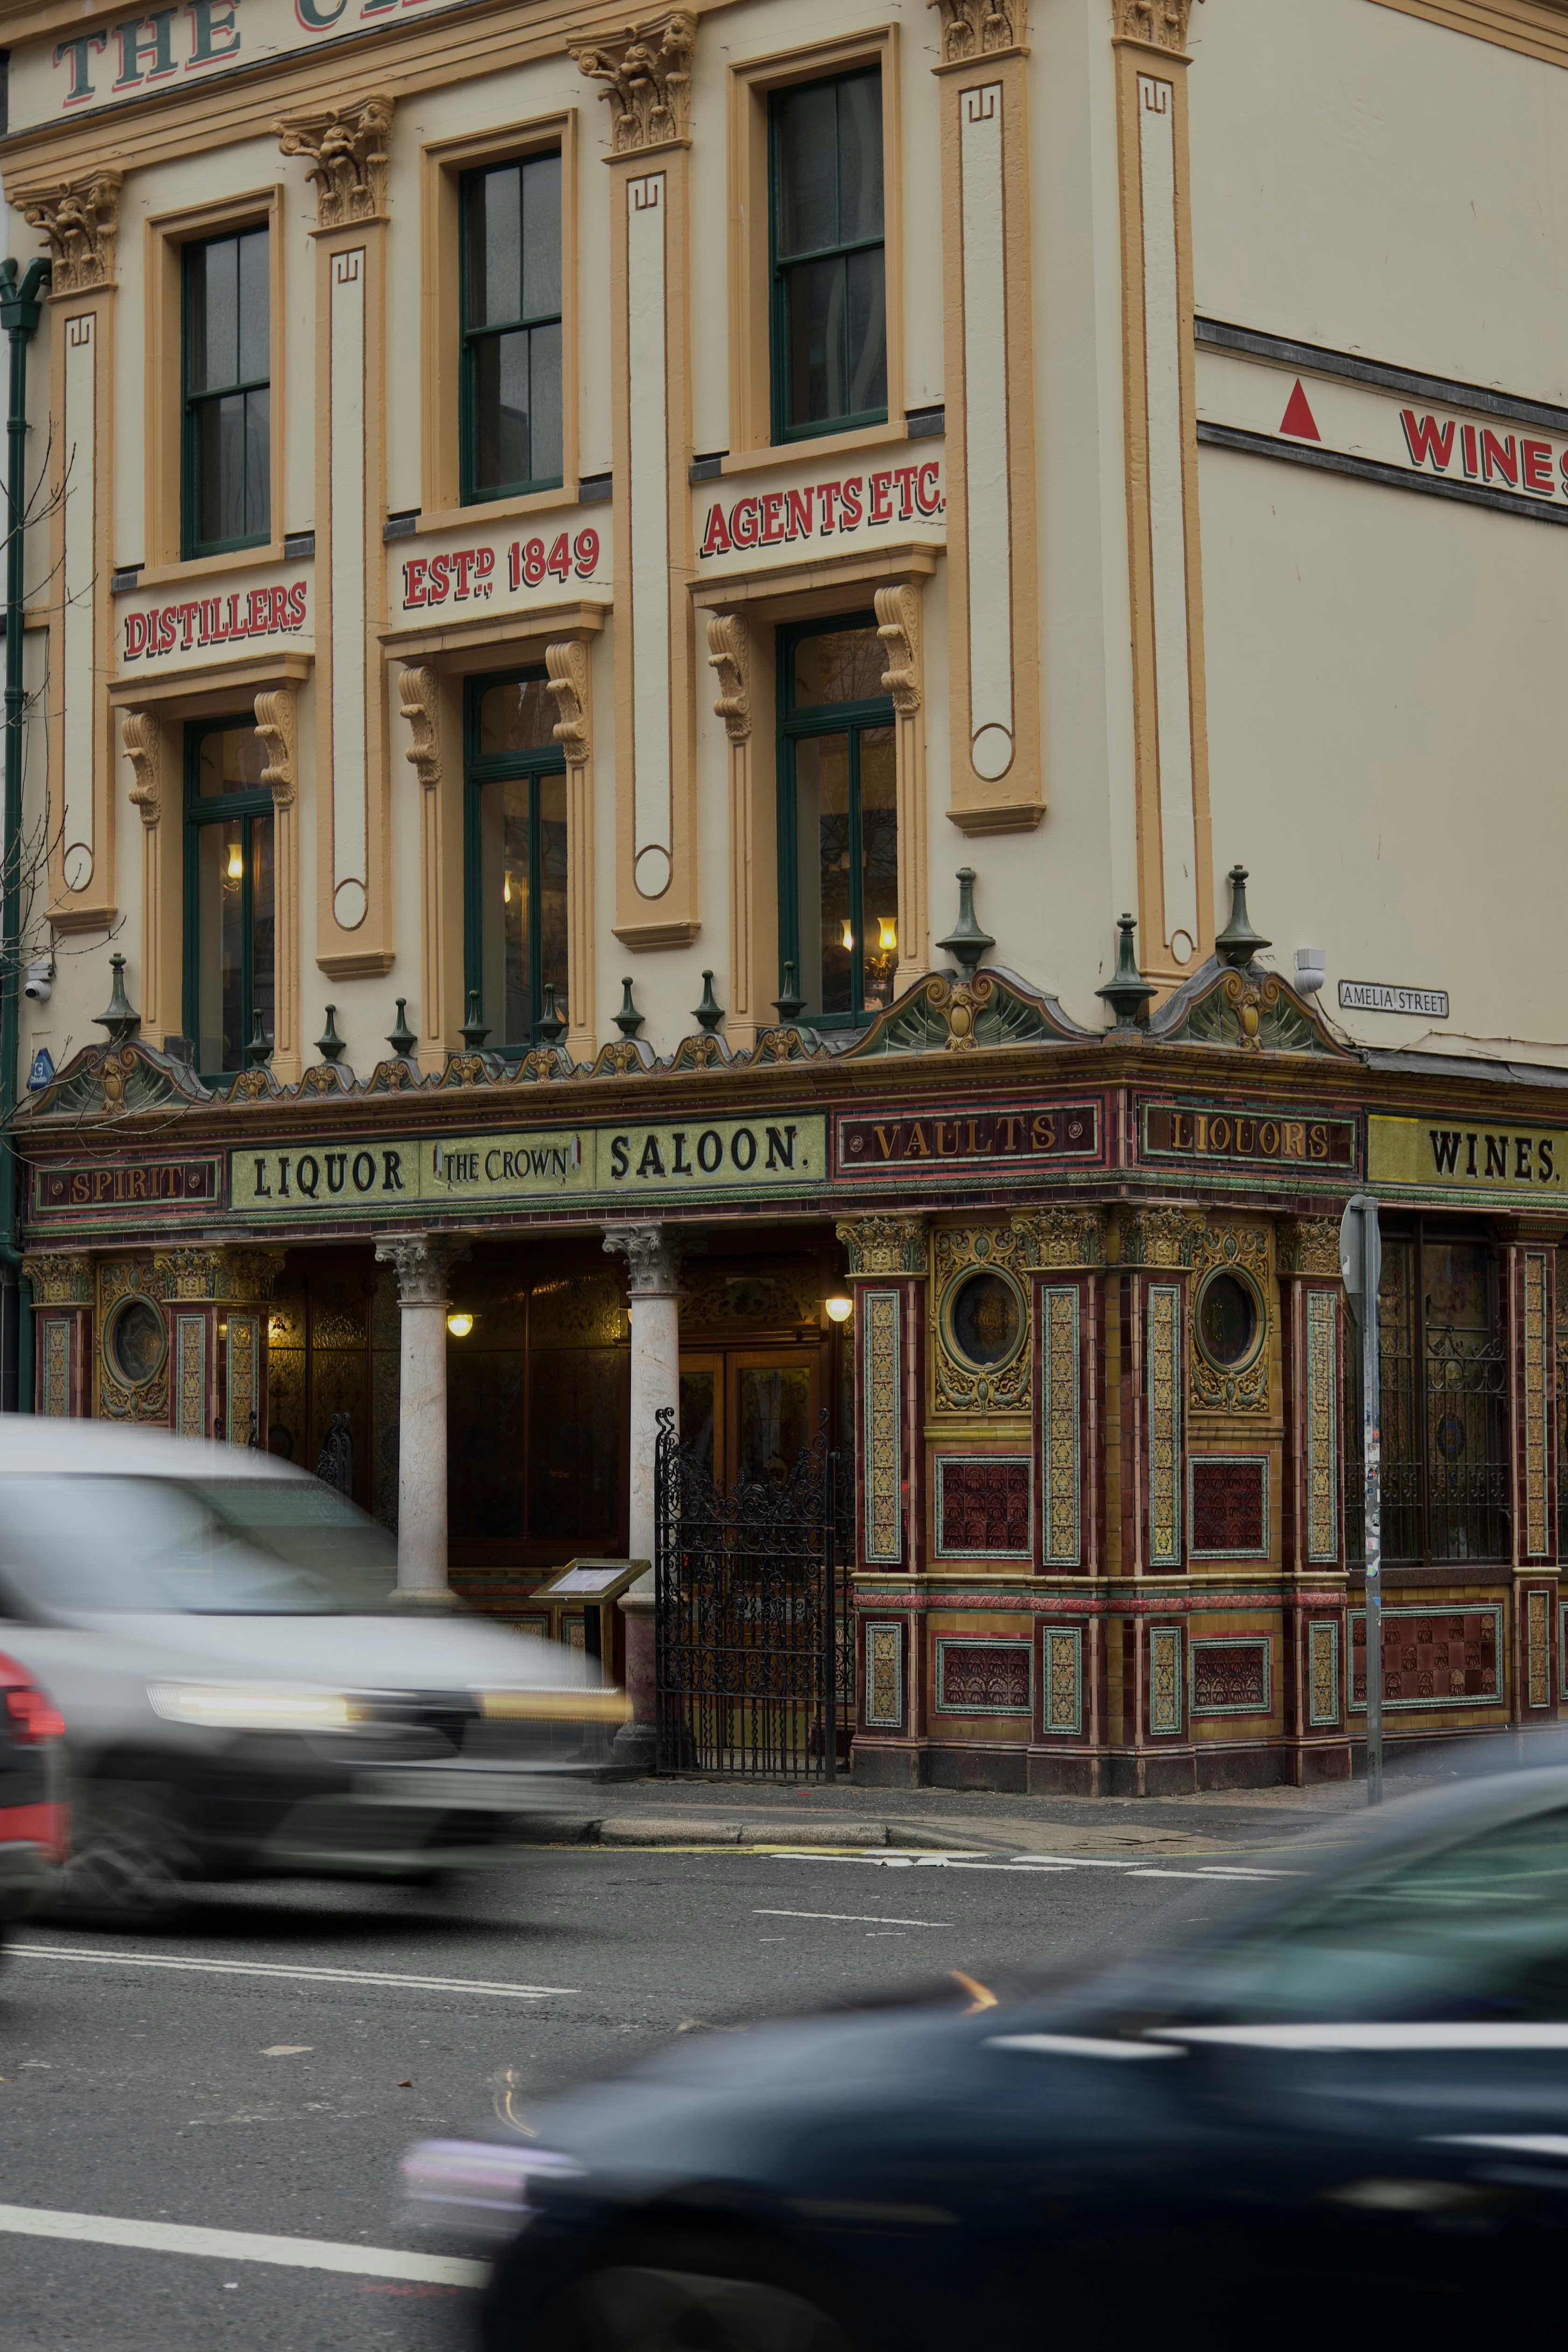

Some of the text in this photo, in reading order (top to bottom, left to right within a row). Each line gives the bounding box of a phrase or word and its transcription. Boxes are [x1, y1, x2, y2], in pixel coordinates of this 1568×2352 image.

[52, 0, 241, 108] THE
[1399, 409, 1568, 501] WINE
[700, 461, 946, 559] AGENTS ETC.
[508, 528, 600, 593] 1849
[124, 581, 307, 662] DISTILLERS
[1343, 986, 1446, 1013] AMELIA STREET
[610, 1125, 810, 1180] SALOON.
[873, 1114, 1056, 1159] VAULTS
[1172, 1113, 1328, 1158] LIQUORS
[1429, 1130, 1562, 1184] WINES,
[71, 1165, 183, 1204] SPIRIT
[254, 1151, 405, 1200] LIQUOR
[444, 1148, 569, 1183] THE CROWN
